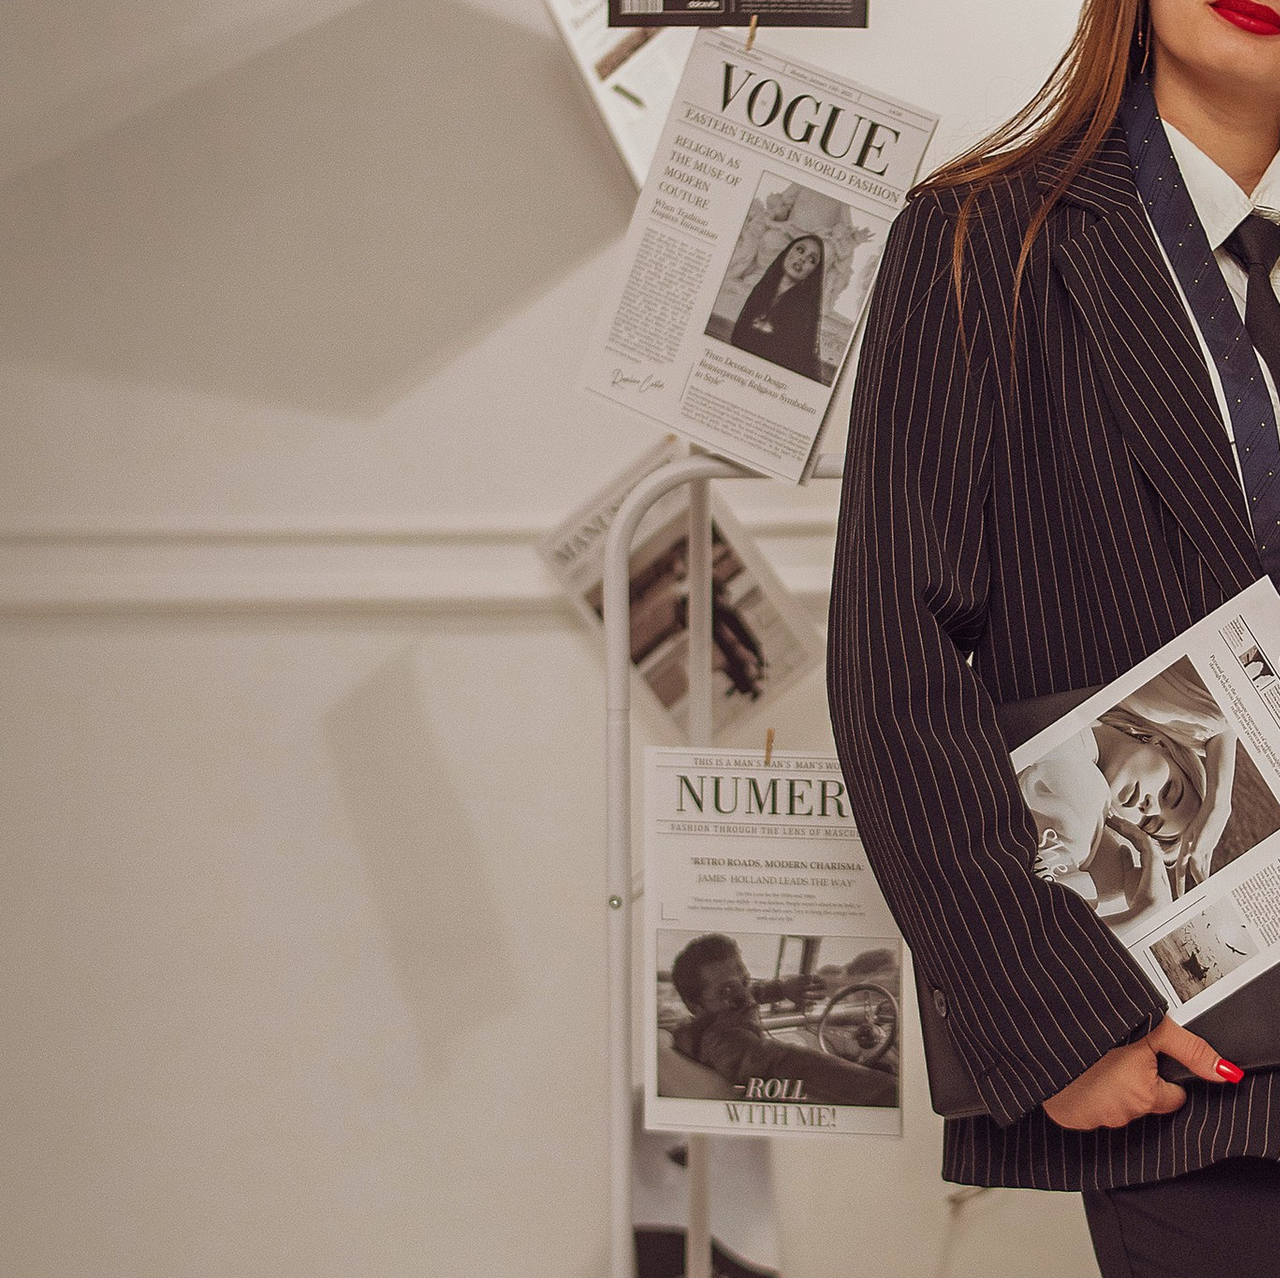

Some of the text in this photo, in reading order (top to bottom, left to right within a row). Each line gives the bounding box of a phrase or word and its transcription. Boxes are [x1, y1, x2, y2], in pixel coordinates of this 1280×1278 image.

[719, 60, 901, 177] VOGUE
[673, 133, 742, 171] RELIGION AS
[684, 106, 901, 204] EASTERN TRENDS IN WORLD FASHION
[663, 164, 711, 193] MODERN
[668, 149, 742, 188] THE MUSE OF
[657, 180, 711, 211] COUTURE
[675, 206, 710, 228] Tradition
[679, 217, 720, 241] Innovation
[694, 368, 704, 378] in
[723, 356, 756, 376] Devotion
[754, 370, 764, 380] to
[697, 358, 817, 416] Reinterpreting Religious Symbolism
[1209, 654, 1224, 674] Personal
[1220, 672, 1230, 683] style
[1229, 686, 1237, 694] the
[1207, 661, 1222, 680] through
[1218, 678, 1230, 692] when
[1225, 690, 1235, 702] you
[1231, 699, 1243, 714] blend
[1259, 743, 1268, 754] with
[1229, 704, 1241, 720] reflect
[1237, 719, 1247, 731] your
[694, 757, 713, 766] THIS
[714, 758, 724, 766] IS
[725, 758, 732, 766] A
[734, 758, 762, 768] MAN'S
[795, 760, 823, 770] MAN'S
[677, 775, 849, 818] NUMER
[670, 822, 861, 838] FASHION THROUGH THE LENS OF MASCU
[727, 859, 763, 868] ROADS,
[765, 860, 808, 870] MODERN
[809, 861, 865, 871] CHARISMA:
[698, 873, 727, 884] JAMES
[730, 875, 778, 885] HOLLAND
[778, 876, 809, 886] LEADS
[810, 878, 829, 886] THE
[723, 1102, 838, 1128] WITH ME!
